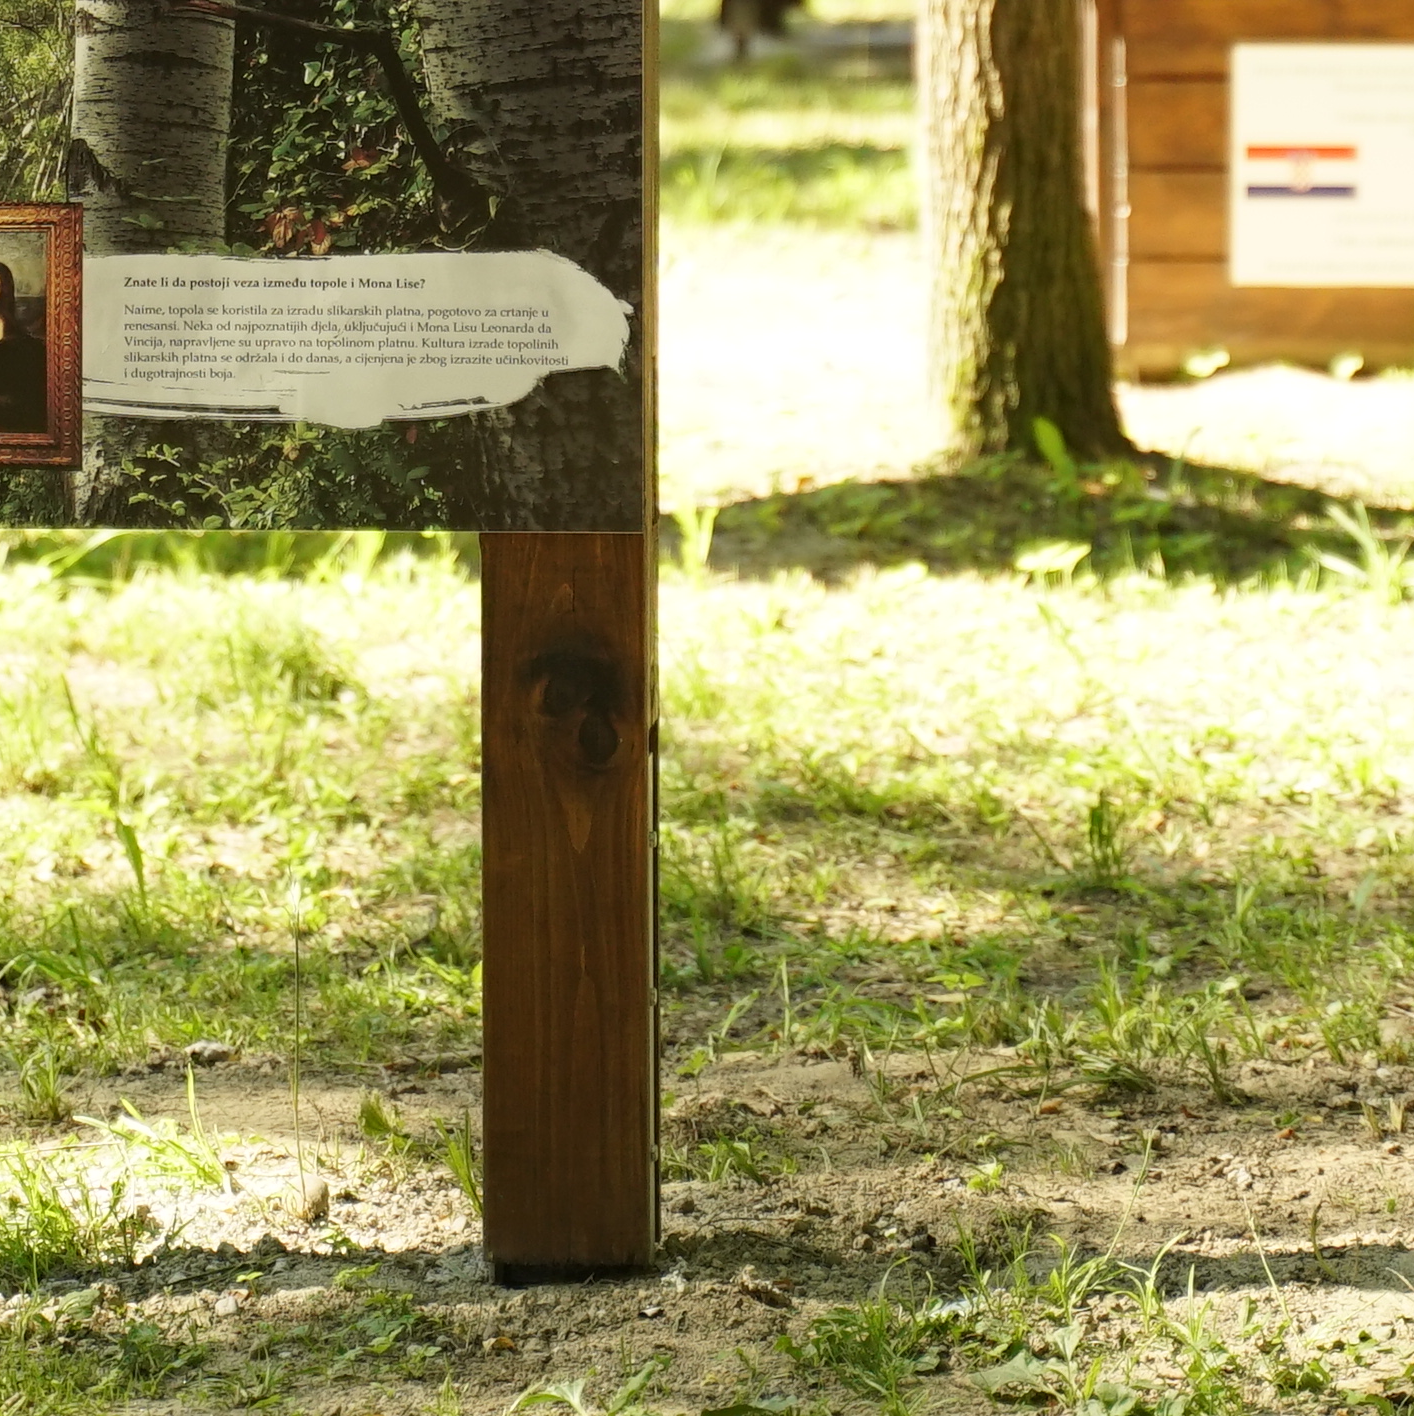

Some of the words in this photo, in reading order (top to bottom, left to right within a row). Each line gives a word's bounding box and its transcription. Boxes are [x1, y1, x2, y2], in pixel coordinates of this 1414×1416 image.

[123, 276, 157, 287] Znate
[160, 276, 168, 287] li
[171, 276, 186, 287] da
[189, 276, 229, 290] postoji
[233, 279, 259, 287] veza
[263, 276, 306, 287] između
[310, 277, 347, 291] topole
[358, 277, 392, 288] Mona
[396, 278, 425, 289] Lise?
[130, 367, 206, 381] dugotrajnosti
[209, 367, 235, 381] boja.
